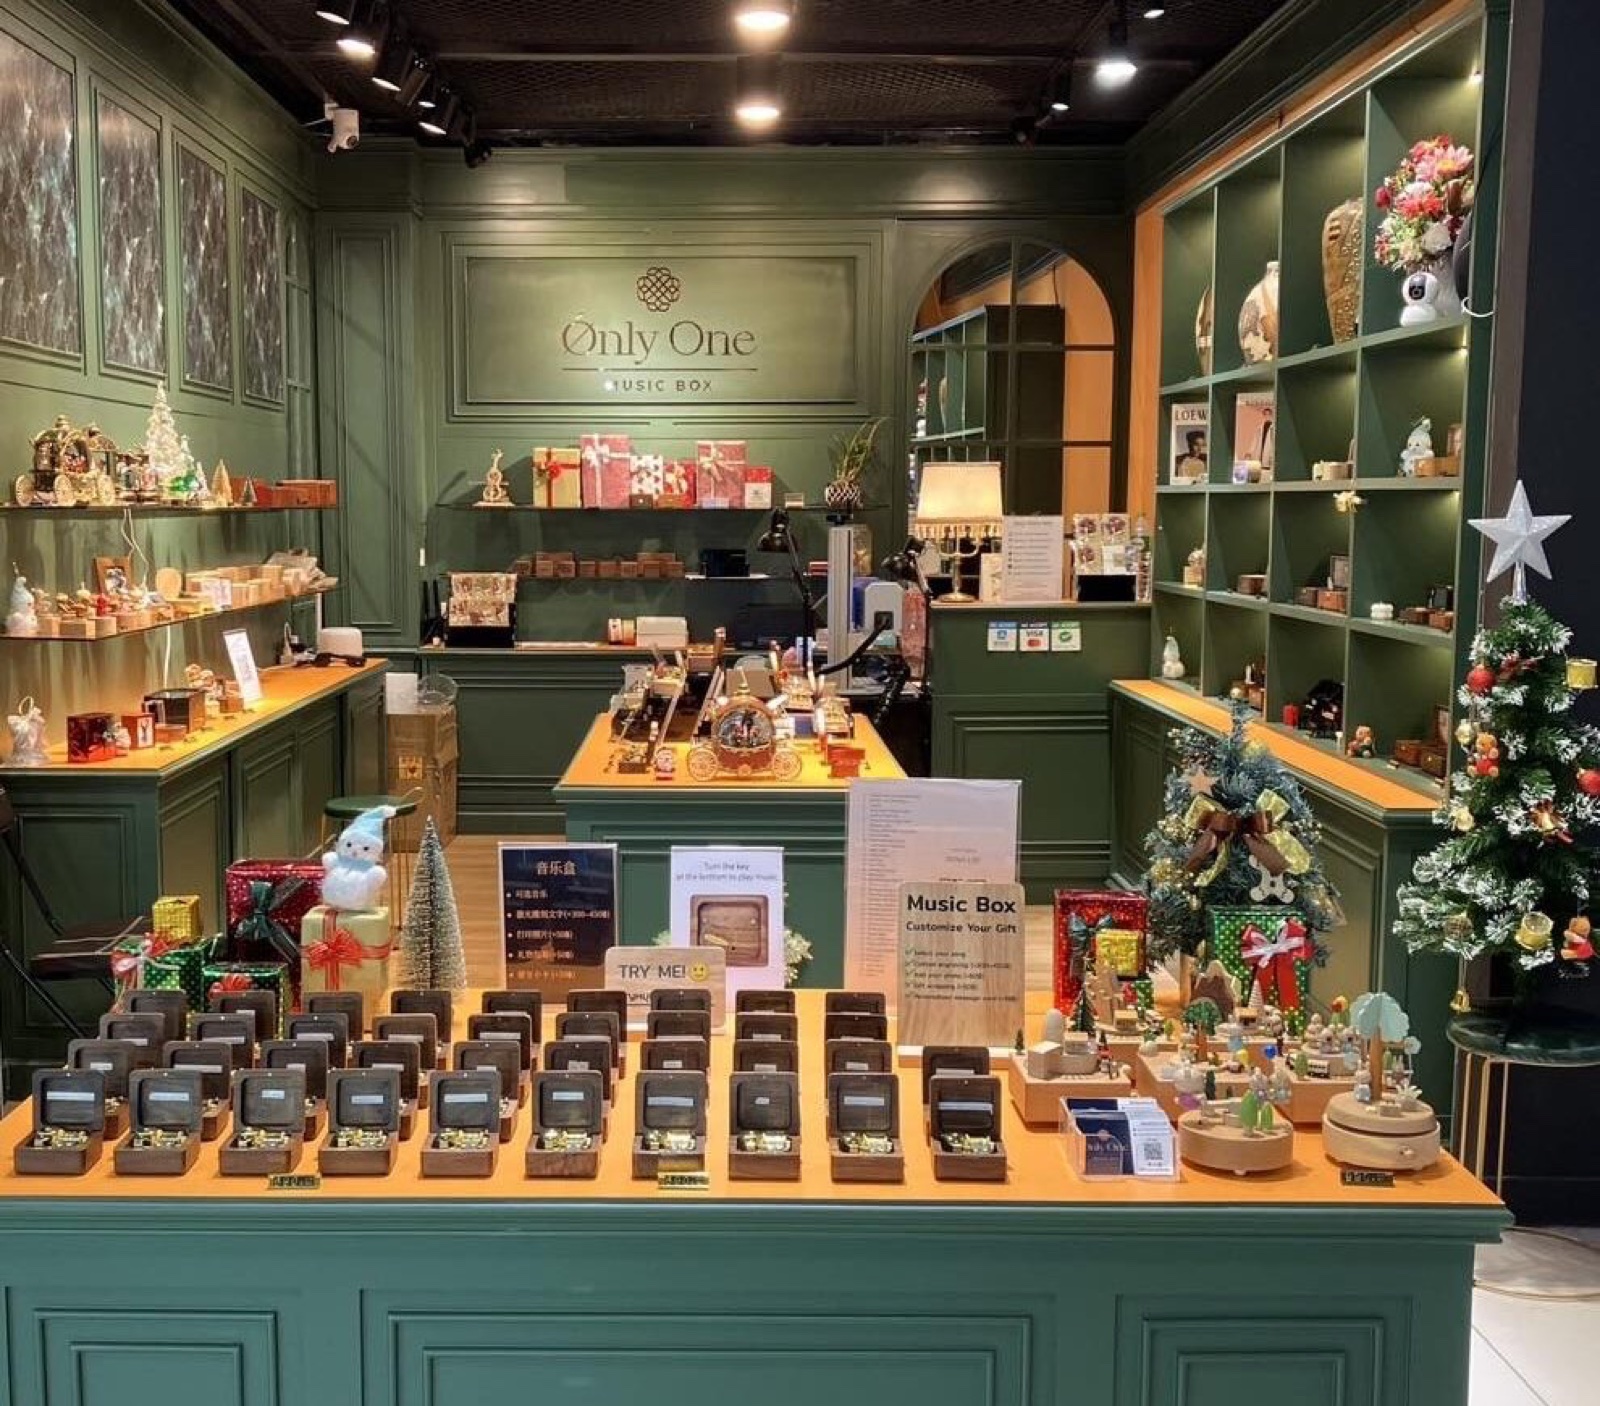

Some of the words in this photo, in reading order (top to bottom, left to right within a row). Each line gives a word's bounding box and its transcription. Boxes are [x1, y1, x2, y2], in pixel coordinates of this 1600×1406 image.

[669, 319, 757, 356] One
[605, 379, 665, 392] USIC
[676, 379, 712, 392] BOX
[537, 860, 577, 876] 音乐盒
[907, 893, 968, 912] Music
[976, 896, 1016, 913] Box
[906, 920, 963, 932] Customize
[967, 923, 992, 933] Your
[996, 923, 1017, 933] Gift
[618, 964, 651, 978] TRY
[658, 964, 686, 978] ME!
